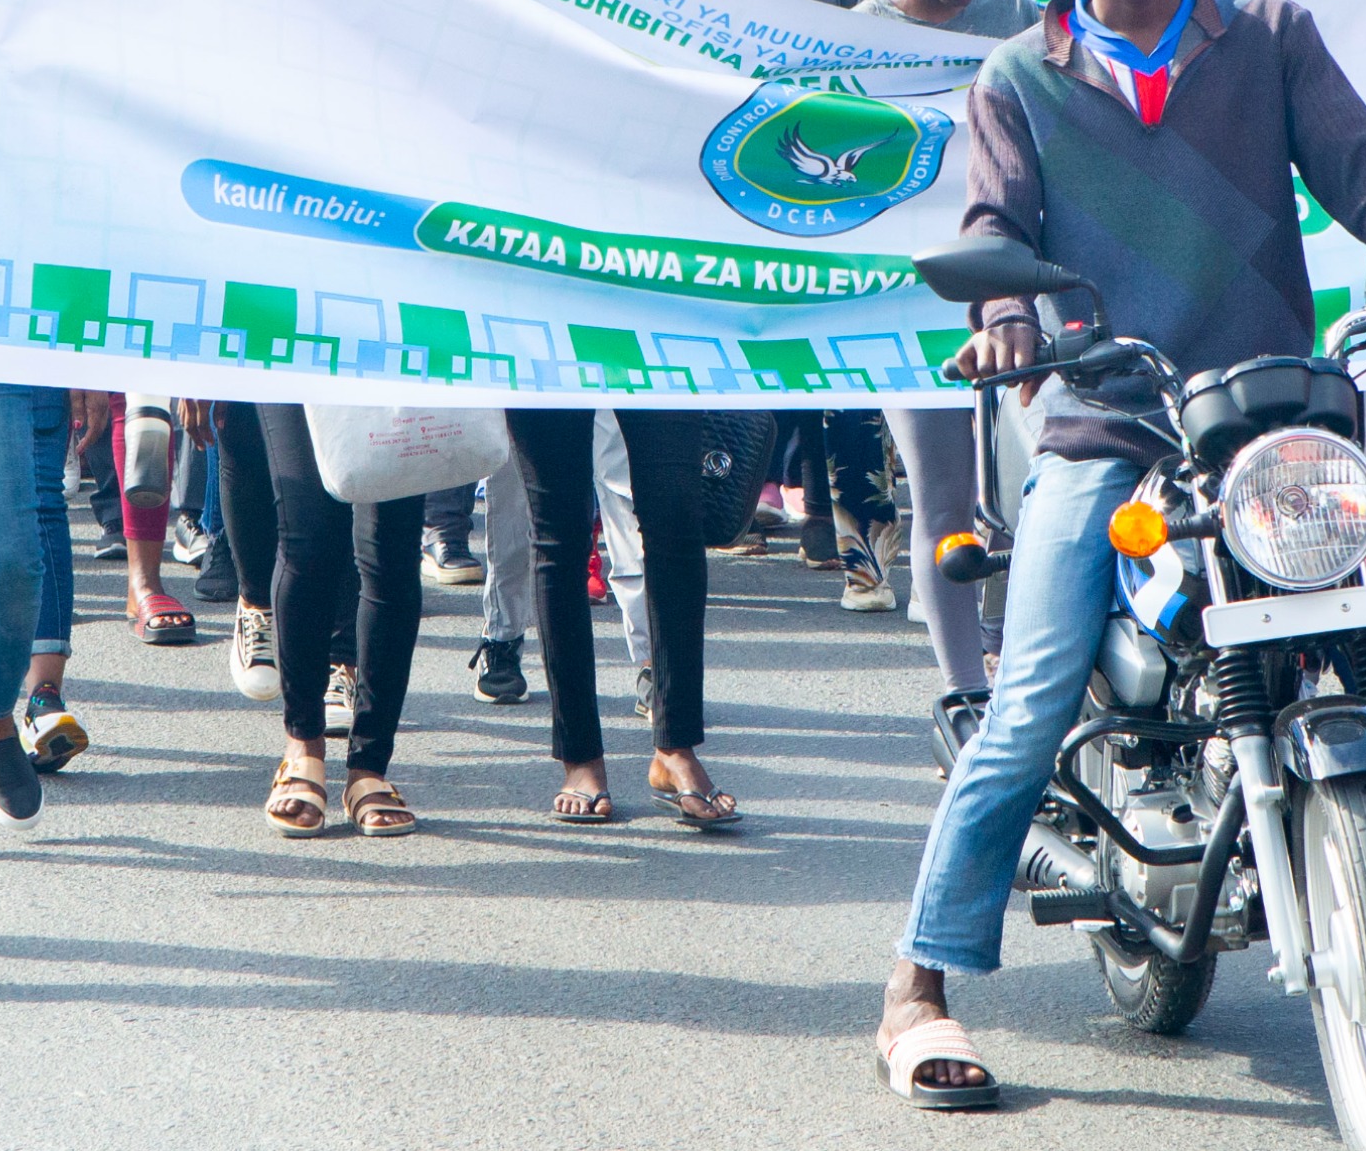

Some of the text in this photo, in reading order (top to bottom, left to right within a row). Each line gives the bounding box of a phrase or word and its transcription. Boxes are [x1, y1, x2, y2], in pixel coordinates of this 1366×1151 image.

[661, 9, 745, 51] OFISI
[755, 45, 788, 66] YA
[698, 4, 730, 28] YA
[743, 19, 921, 61] MUUNGANO
[698, 41, 742, 72] NA
[717, 98, 778, 152] CONTROL
[713, 159, 734, 182] DRUG
[213, 174, 386, 228] kauli mbiu:
[767, 202, 836, 226] DCEA
[444, 219, 918, 298] KATAA DAWA ZA KULEVYA
